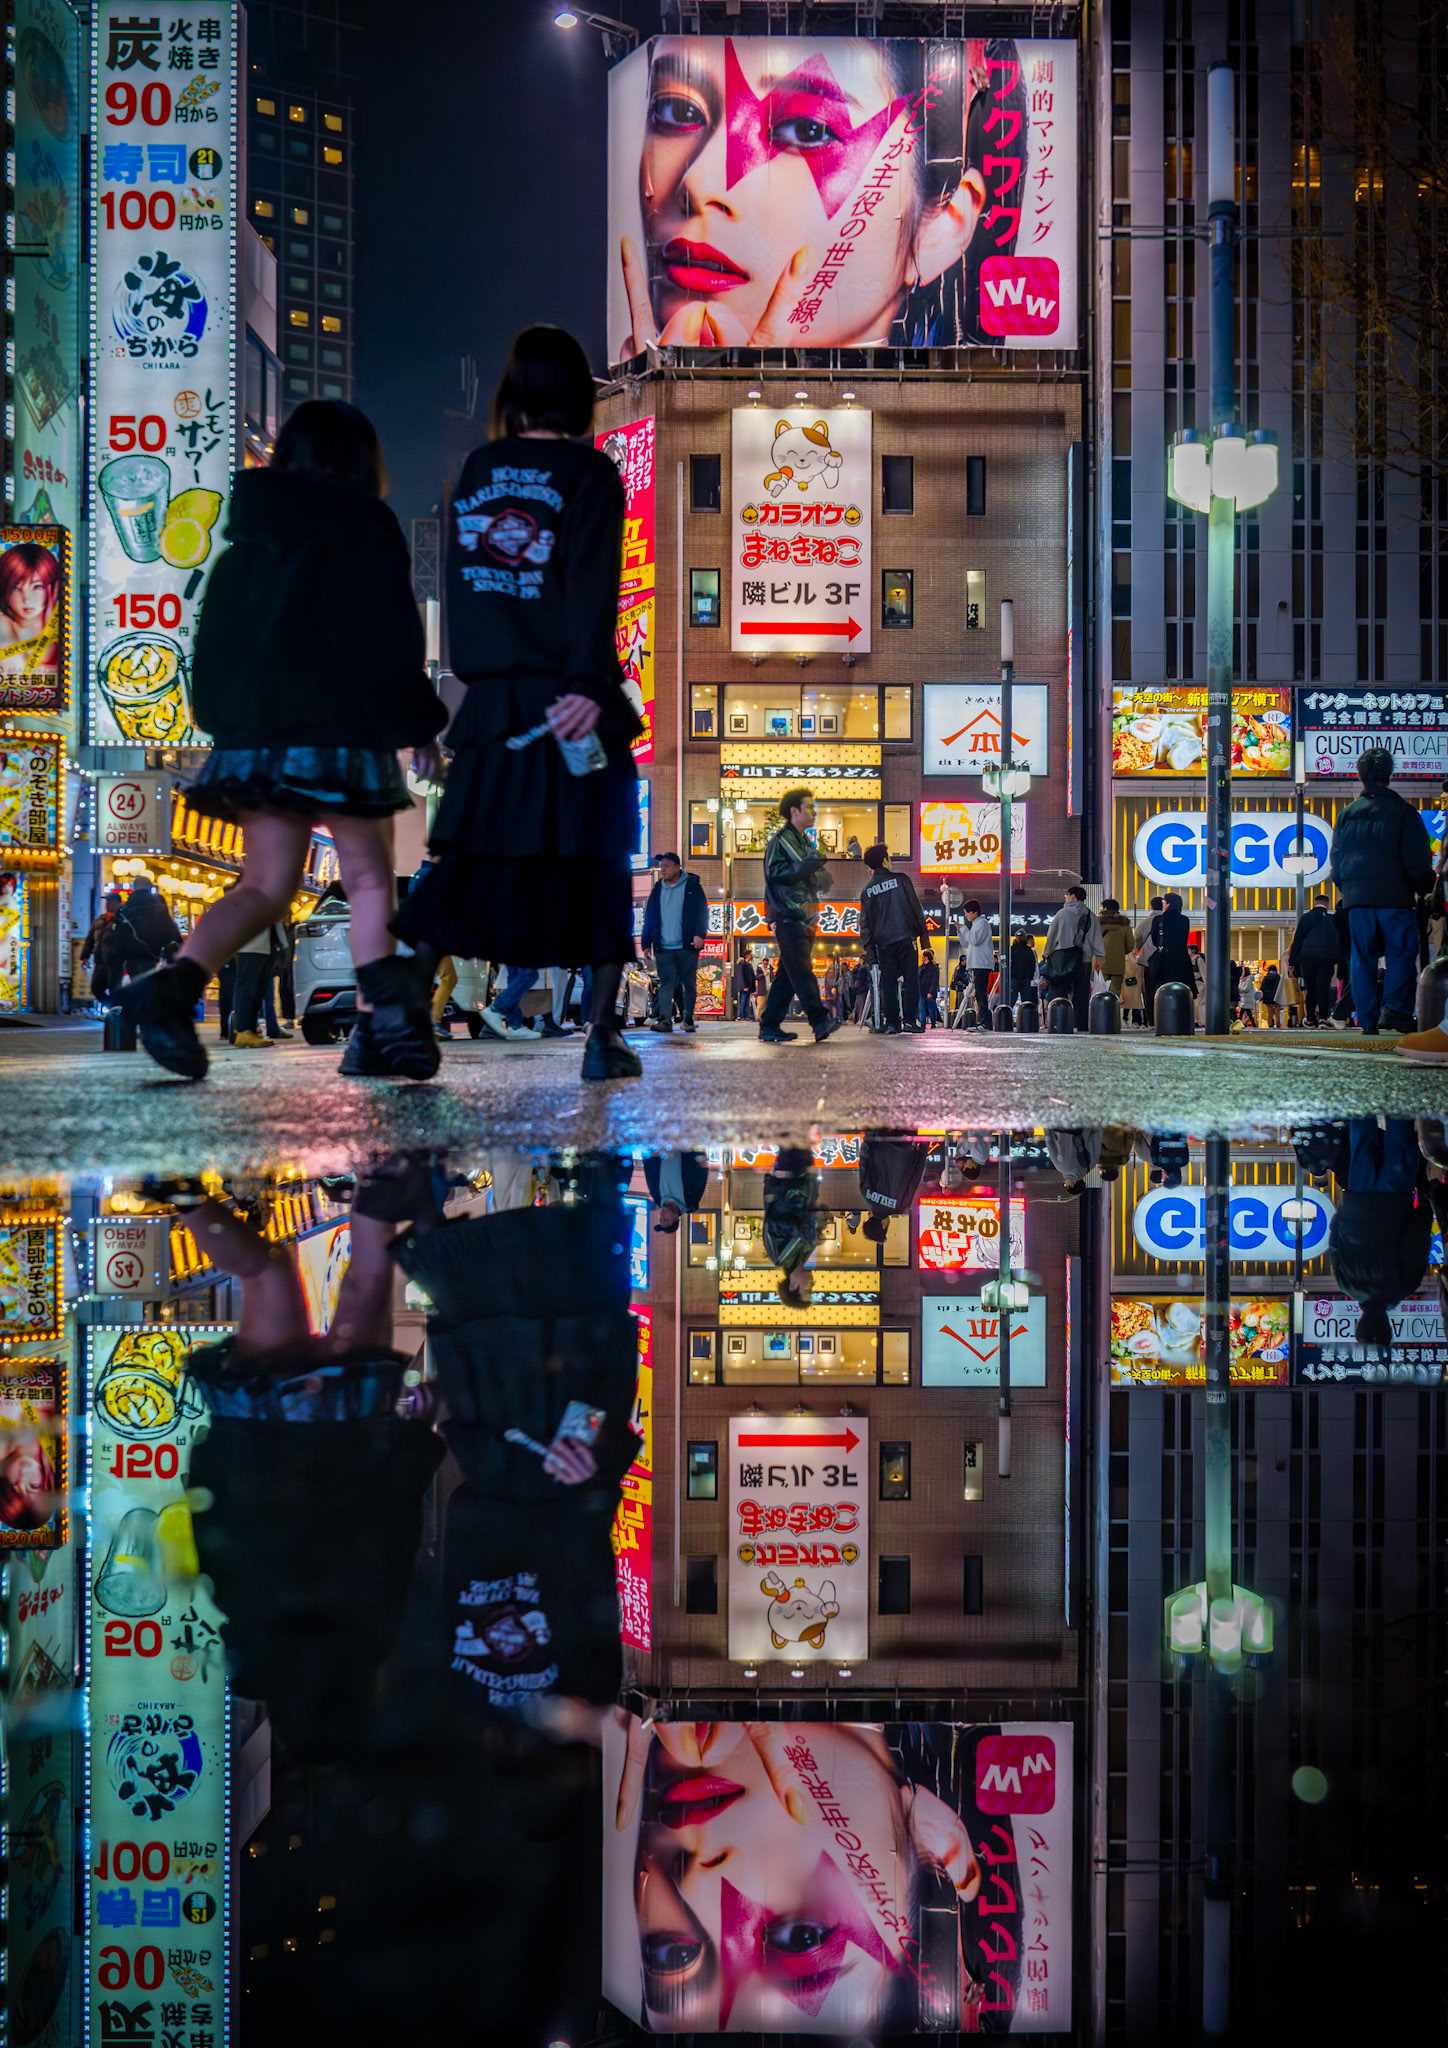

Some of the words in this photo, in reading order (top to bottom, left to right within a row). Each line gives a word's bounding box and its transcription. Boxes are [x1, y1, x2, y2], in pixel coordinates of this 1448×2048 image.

[106, 17, 162, 71] 炭
[105, 82, 171, 126] 90
[174, 107, 218, 123] 円から
[197, 150, 213, 164] 21
[983, 57, 1022, 248] ワクワク
[1032, 60, 1054, 245] 劇的マッチング
[102, 143, 187, 184] 寿司
[100, 191, 176, 230] 100
[180, 214, 223, 230] 円から
[127, 335, 199, 358] ちから
[142, 362, 180, 370] CHIKARA
[109, 416, 167, 451] 50
[166, 447, 175, 456] 円
[759, 502, 846, 526] カラオケ
[741, 531, 863, 568] まねきねこ
[742, 582, 817, 605] 隣ビル
[825, 583, 861, 605] 3F
[113, 593, 182, 629] 150
[179, 626, 188, 636] 円
[1304, 692, 1444, 710] インターネットカフェ
[1267, 713, 1282, 722] RF
[1322, 711, 1448, 725] 完全個室・完全防音
[1413, 735, 1448, 755] CAF
[743, 766, 880, 778] 山下本気うどん
[117, 794, 136, 811] 24
[107, 823, 147, 831] ALWAYS
[106, 832, 148, 845] OPEN
[934, 833, 999, 862] 好みの
[866, 878, 897, 898] POLIZEI
